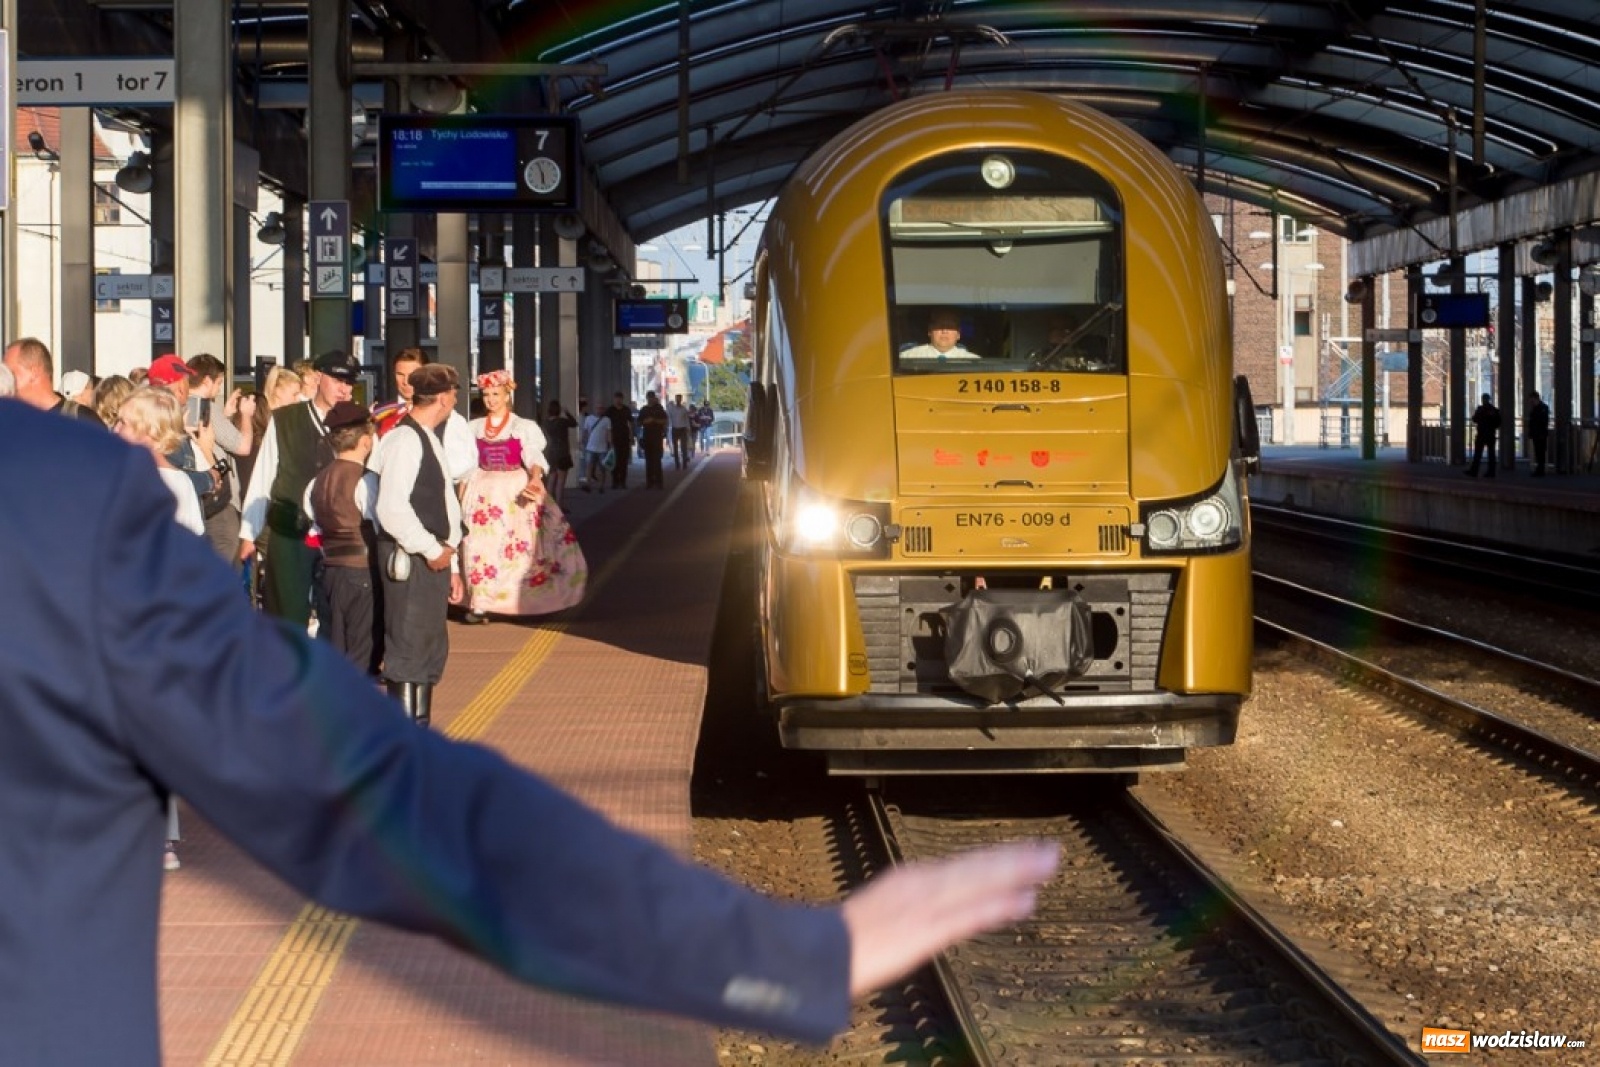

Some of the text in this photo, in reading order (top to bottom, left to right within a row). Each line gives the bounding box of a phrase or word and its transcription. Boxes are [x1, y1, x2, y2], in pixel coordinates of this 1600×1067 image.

[17, 72, 168, 91] eron 1 tor 7
[392, 130, 508, 141] 18:18 Tychy Lodowisko
[535, 130, 549, 150] 7
[551, 275, 559, 288] C
[98, 282, 106, 296] C
[958, 379, 1061, 393] 2 140 158-8
[956, 513, 1004, 527] EN76
[1021, 512, 1054, 527] 009
[1059, 512, 1071, 527] d
